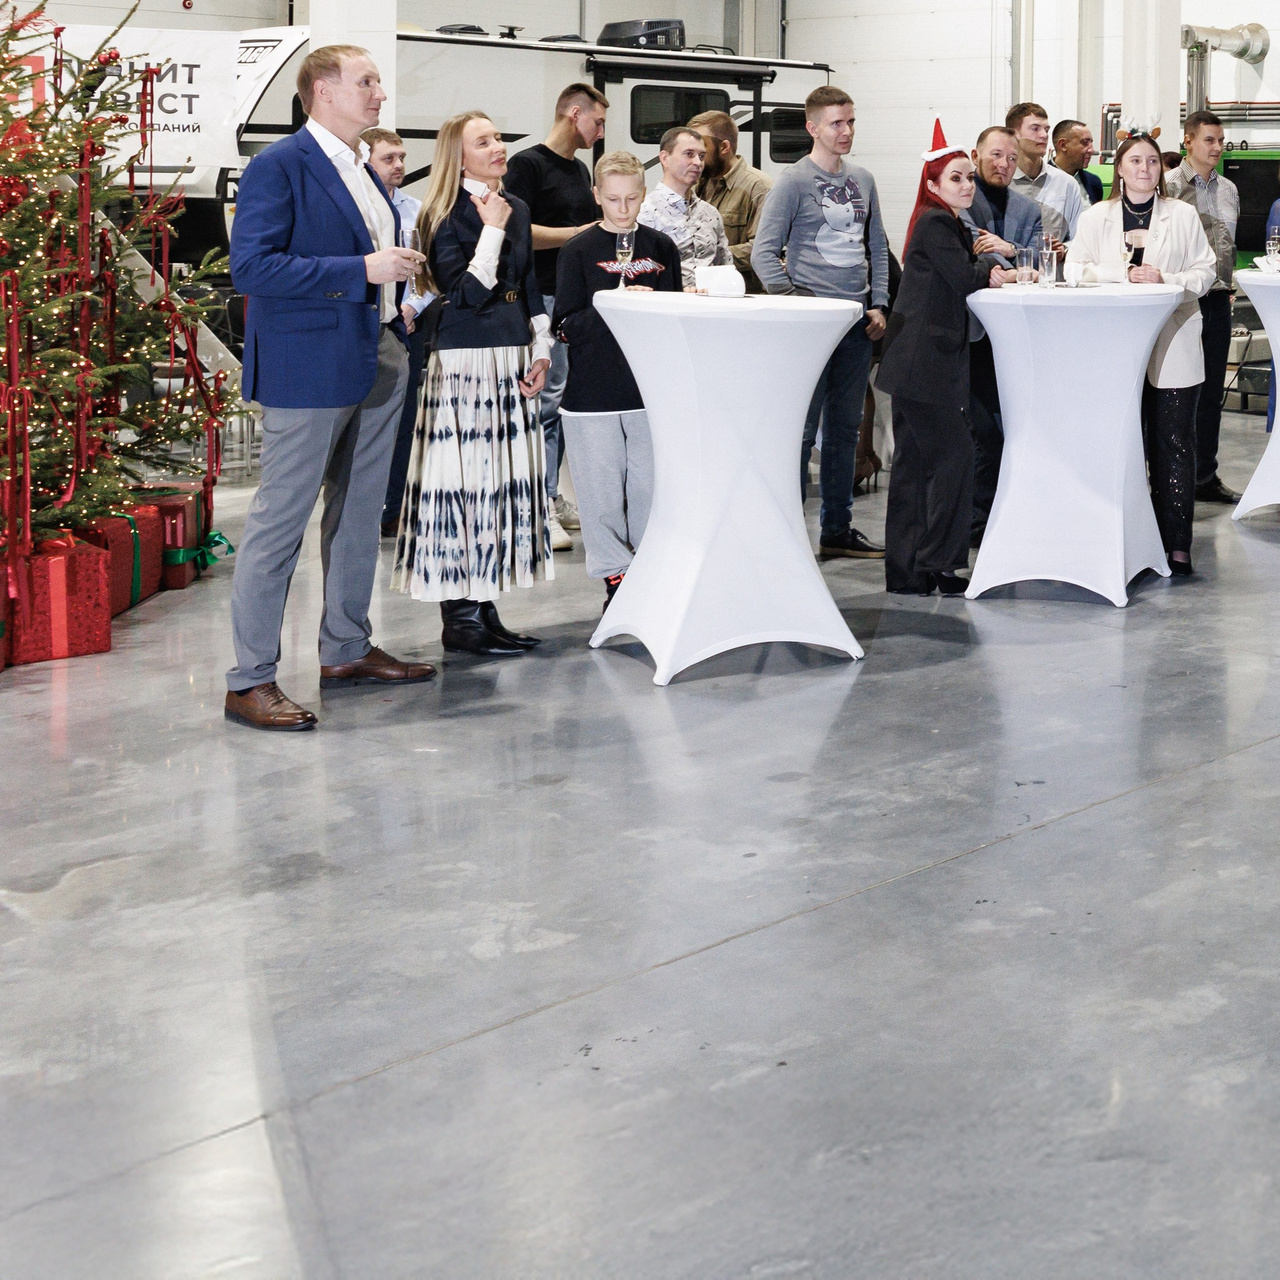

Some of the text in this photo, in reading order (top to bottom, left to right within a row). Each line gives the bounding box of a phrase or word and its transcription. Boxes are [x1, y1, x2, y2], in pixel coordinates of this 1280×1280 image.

[57, 58, 201, 84] НИТ
[58, 87, 200, 114] ВЕСТ
[119, 121, 201, 133] КОПАНИЙ
